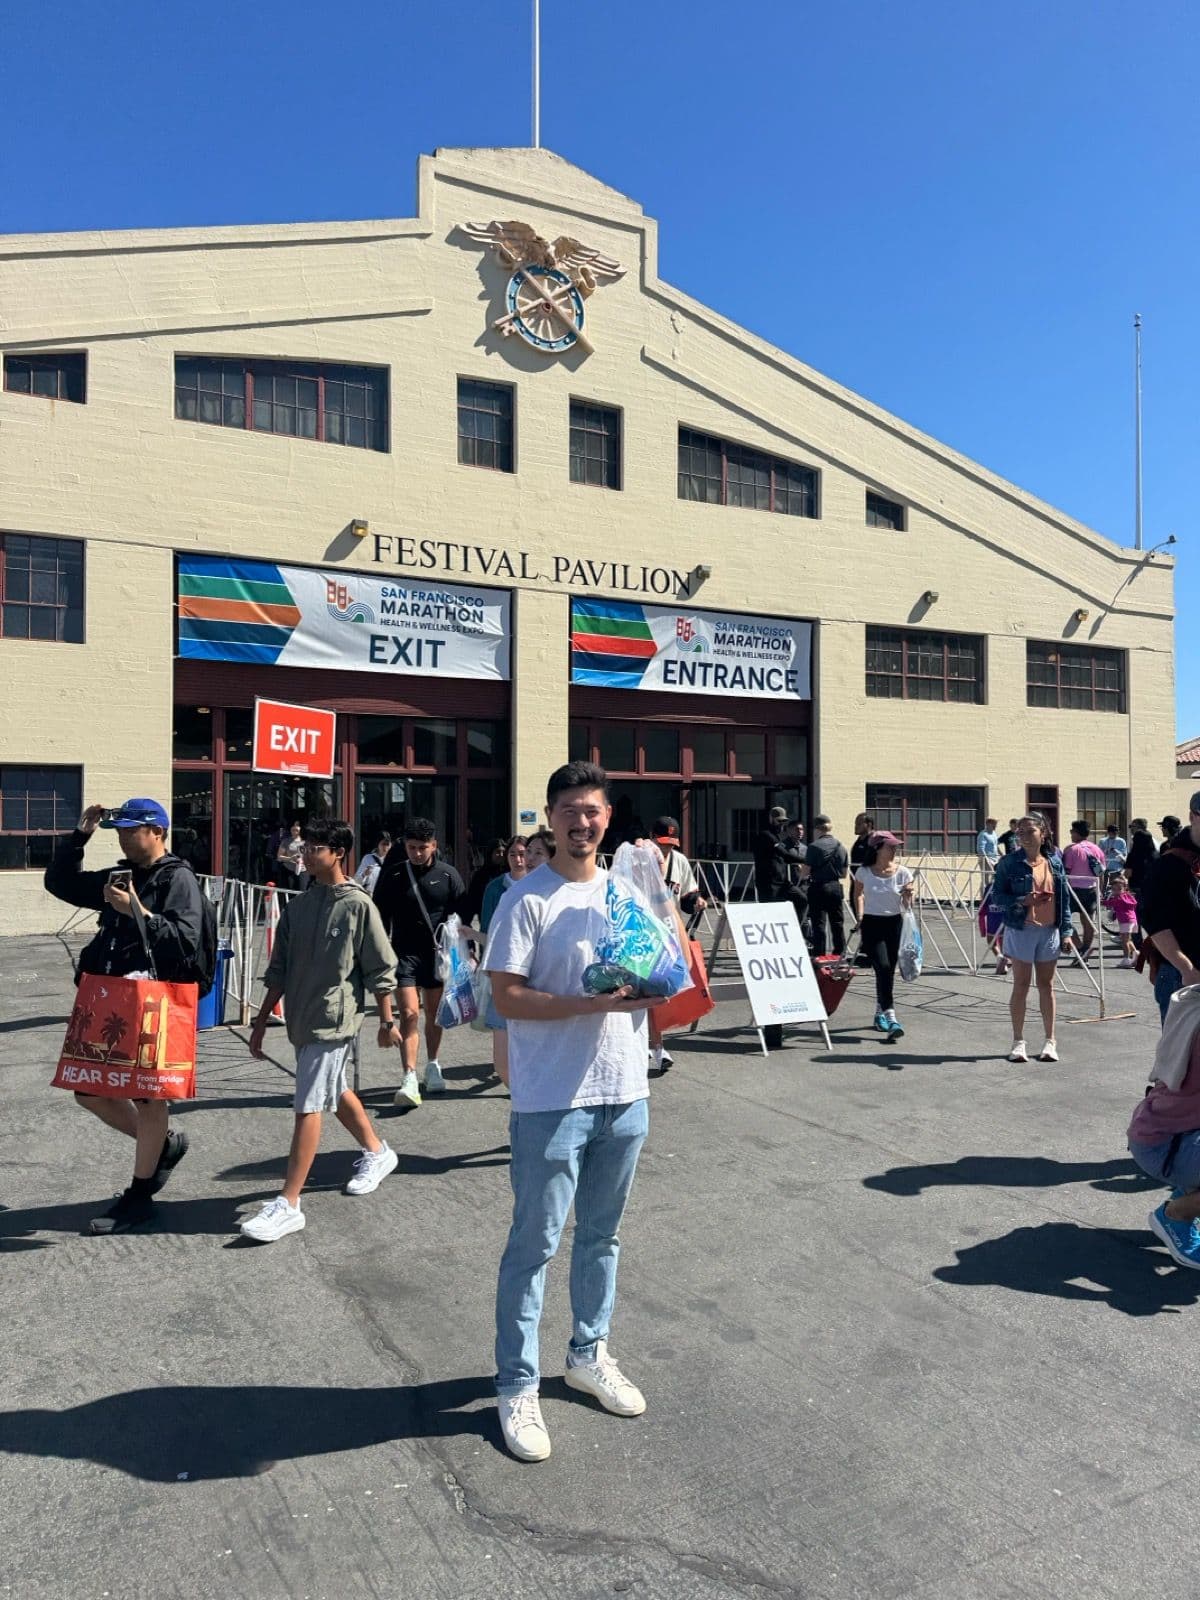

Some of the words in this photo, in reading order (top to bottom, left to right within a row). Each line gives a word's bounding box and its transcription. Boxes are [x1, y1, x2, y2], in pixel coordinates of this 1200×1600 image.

[372, 534, 539, 580] FESTIVAL
[552, 556, 692, 596] PAVILION
[381, 587, 407, 599] SAN
[411, 590, 484, 607] FRANCISCO
[380, 599, 484, 623] MARATHON
[380, 618, 410, 628] HEALTH
[412, 621, 418, 630] &
[419, 622, 460, 633] WELLNESS
[462, 626, 484, 635] EXPO
[715, 621, 735, 632] SAN
[737, 624, 793, 637] FRANCISCO
[369, 634, 446, 668] EXIT
[714, 632, 792, 651] MARATHON
[712, 648, 735, 656] HEALTH
[742, 651, 772, 660] WELLNESS
[773, 653, 790, 661] EXPO
[663, 659, 799, 693] ENTRANCE
[270, 724, 321, 755] EXIT
[742, 922, 789, 945] EXIT
[748, 956, 804, 981] ONLY
[61, 1065, 103, 1084] HEAR
[107, 1072, 131, 1087] SF
[137, 1074, 157, 1083] From
[159, 1074, 185, 1085] Bridge
